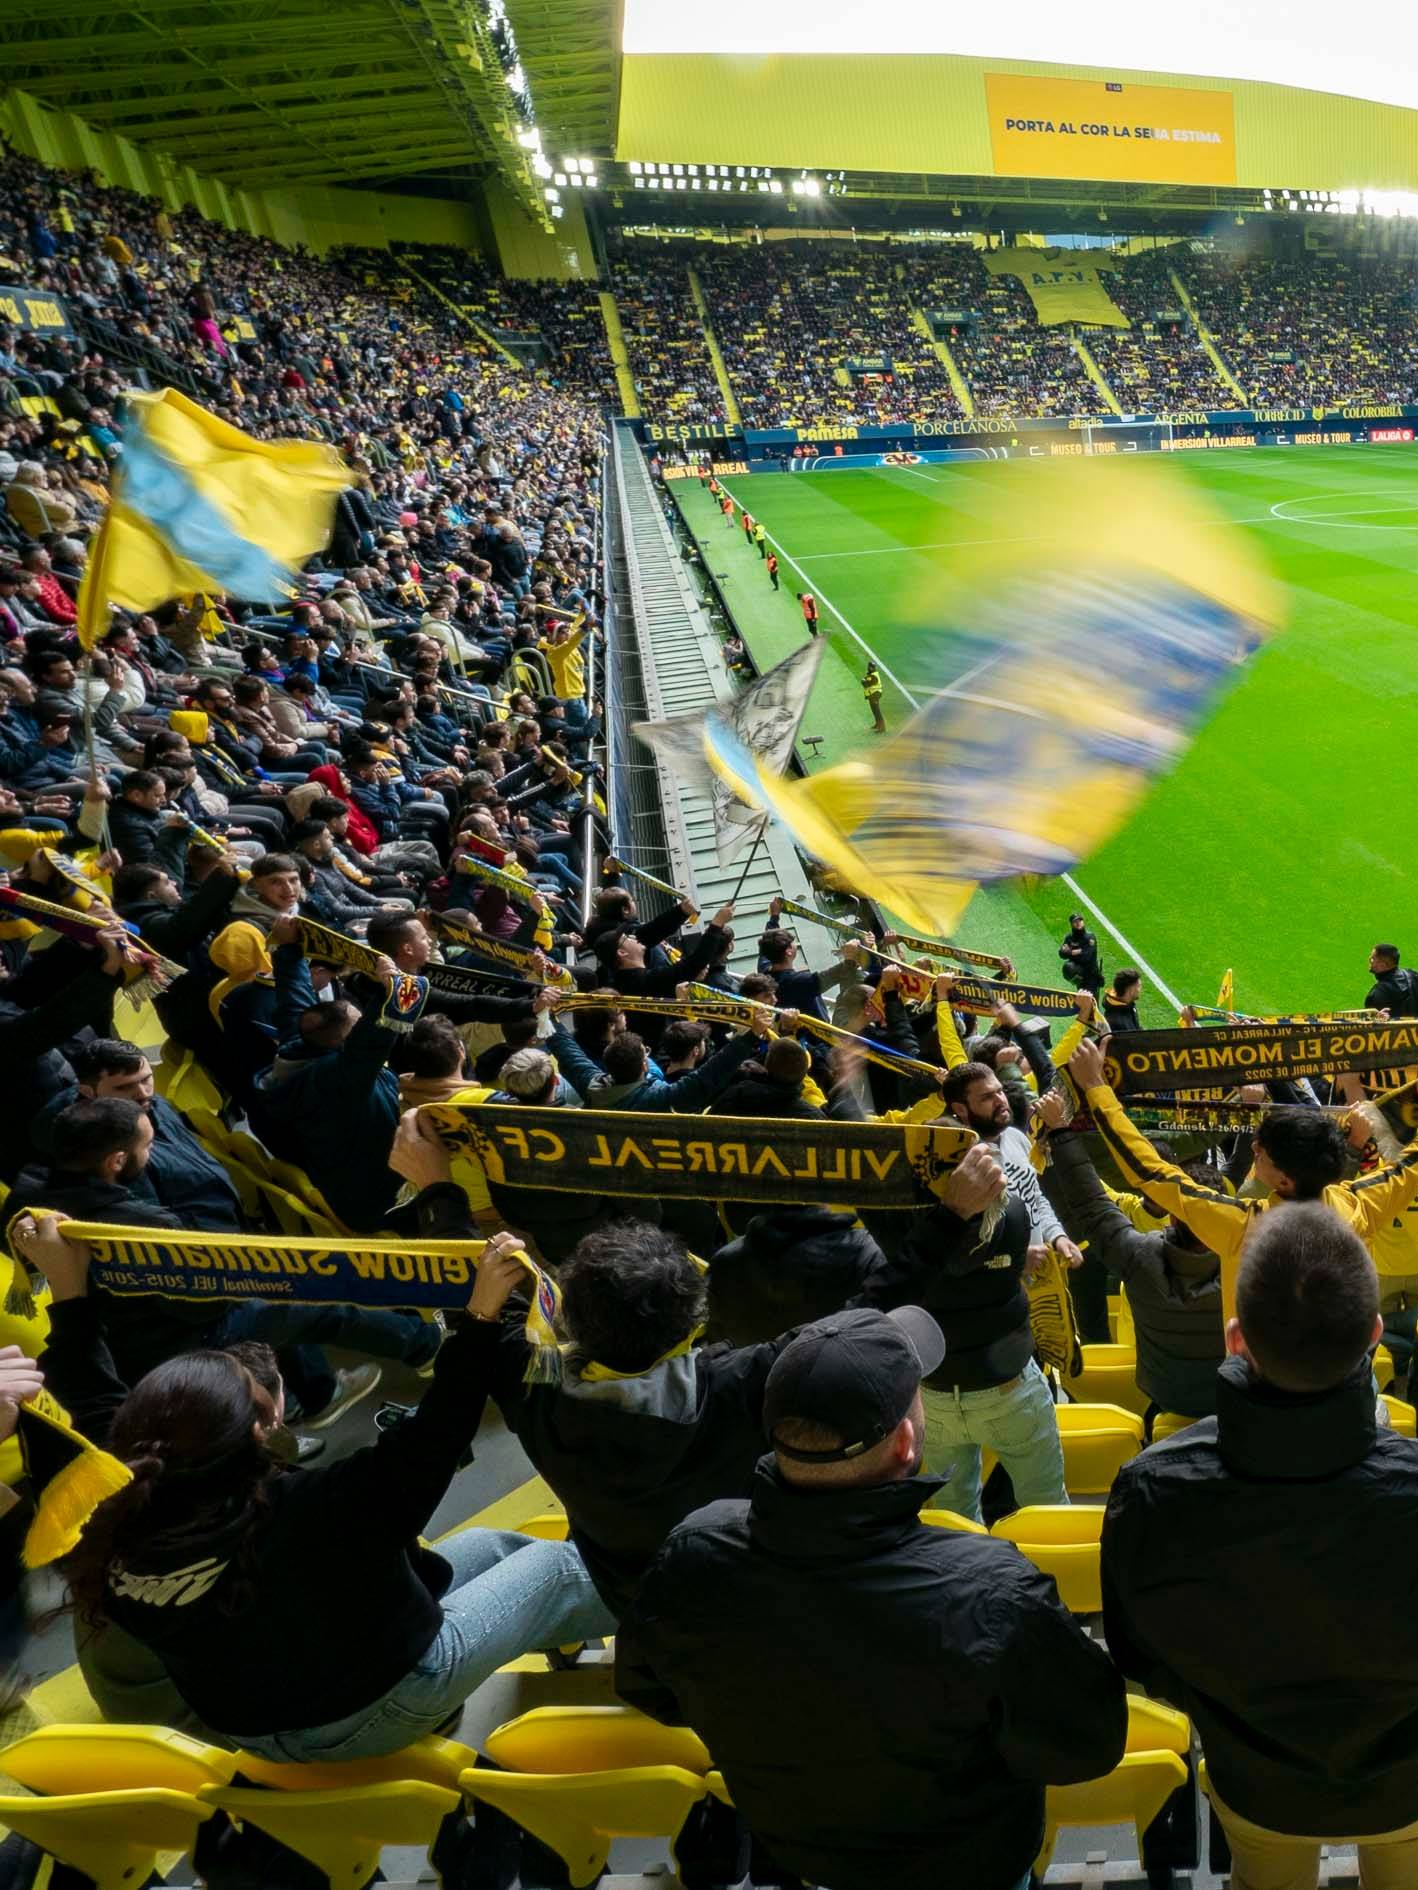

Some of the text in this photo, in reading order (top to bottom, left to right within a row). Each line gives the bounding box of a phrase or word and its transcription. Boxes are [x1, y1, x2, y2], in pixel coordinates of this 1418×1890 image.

[1006, 119, 1054, 133] PORTA
[1059, 122, 1077, 134] AL
[1081, 124, 1109, 137] COR
[1113, 126, 1130, 138] LA
[1173, 129, 1221, 144] ESTIMA
[1343, 405, 1404, 419] COLOROBBIA
[1068, 416, 1104, 429] altadia
[1154, 413, 1209, 426] ARGENTA
[651, 423, 737, 441] BESTILE
[796, 427, 858, 441] PAMESA
[913, 419, 1018, 436] PORCELANOSA
[1295, 433, 1321, 445] MUSEO
[1332, 432, 1352, 444] TOUR
[1372, 430, 1402, 441] LALIGA
